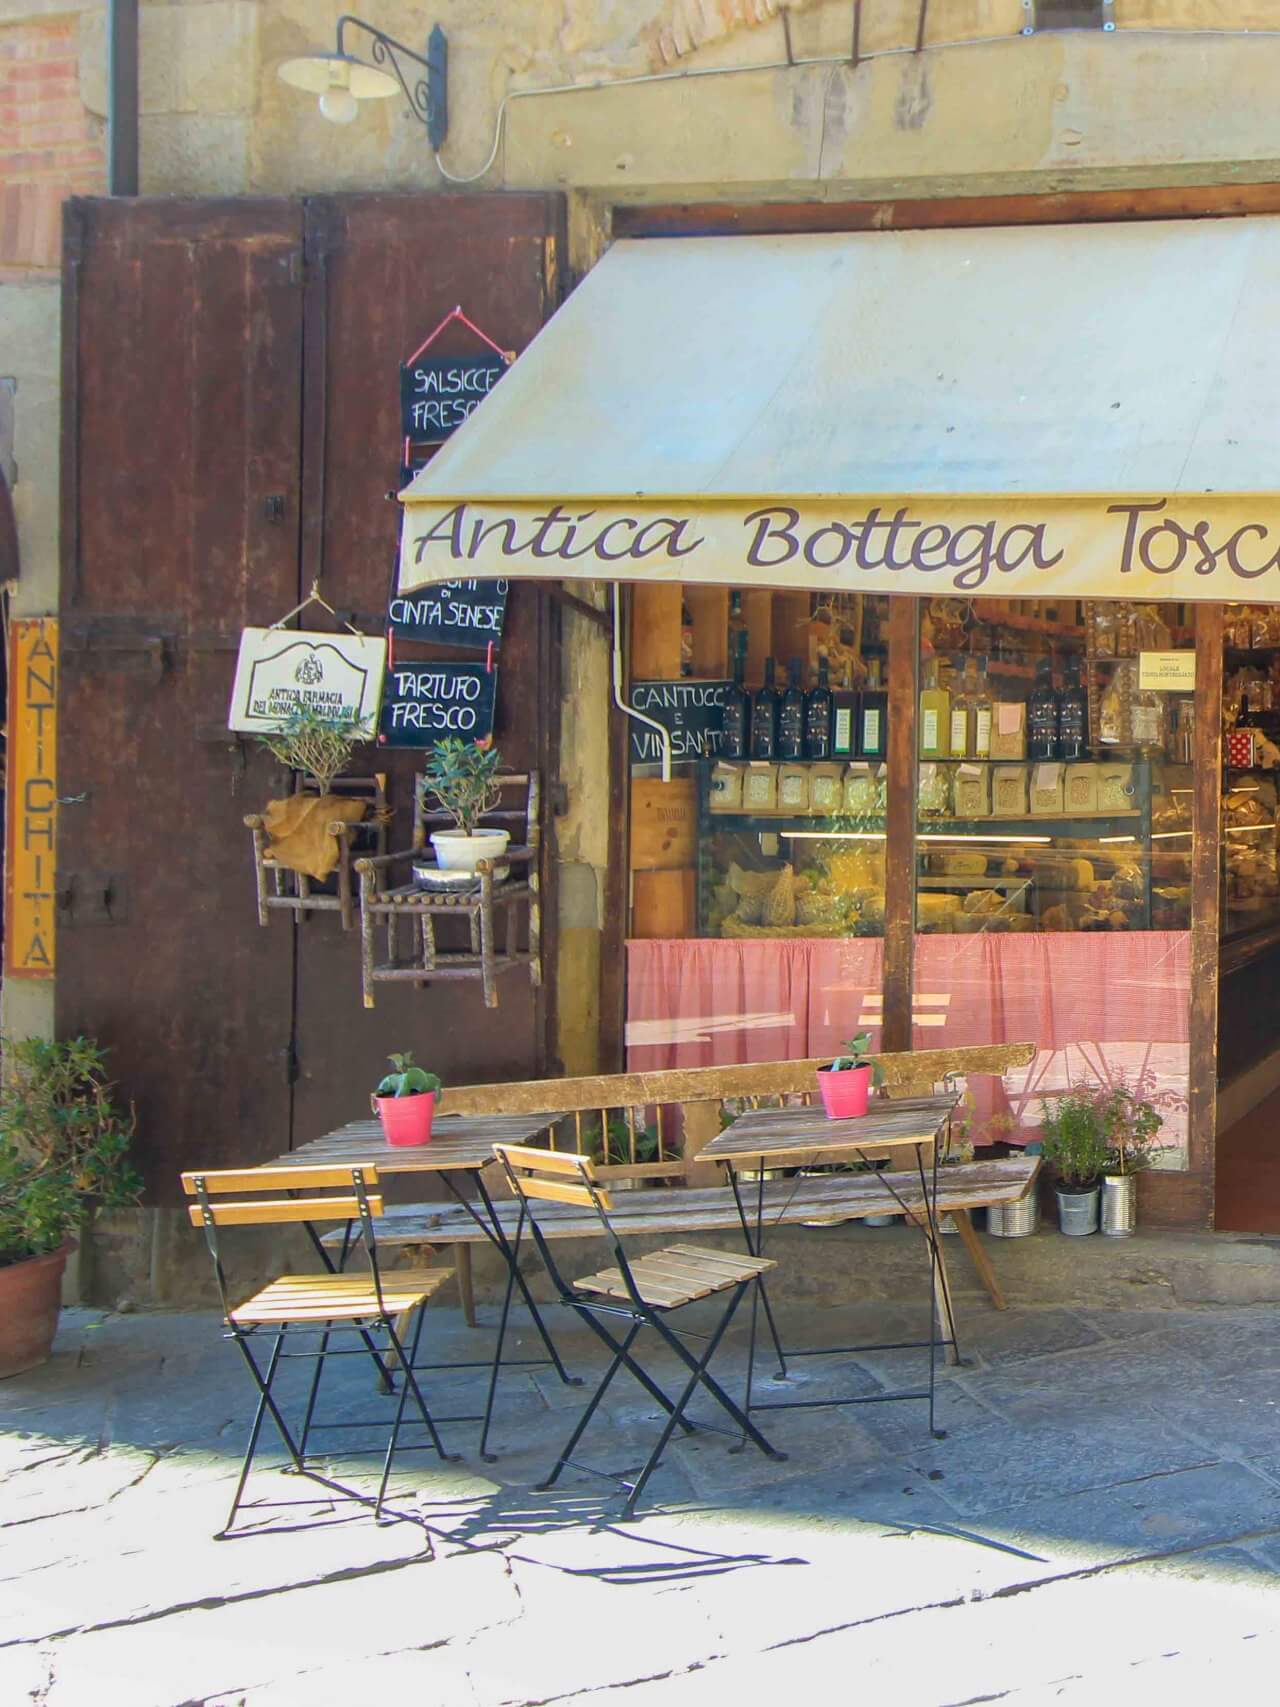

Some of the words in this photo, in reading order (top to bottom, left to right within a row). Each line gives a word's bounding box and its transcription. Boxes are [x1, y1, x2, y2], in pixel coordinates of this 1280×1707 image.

[414, 368, 499, 394] SALSICCE
[411, 398, 480, 430] FRESC
[414, 503, 705, 565] Antica
[743, 506, 1065, 590] Bottega
[389, 599, 442, 626] CINTA
[444, 601, 505, 631] SENESE
[394, 672, 482, 702] TARTUFO
[632, 685, 728, 710] CANTUCC
[391, 702, 477, 731] FRESCO
[673, 712, 684, 725] E
[631, 728, 724, 760] VINSANT
